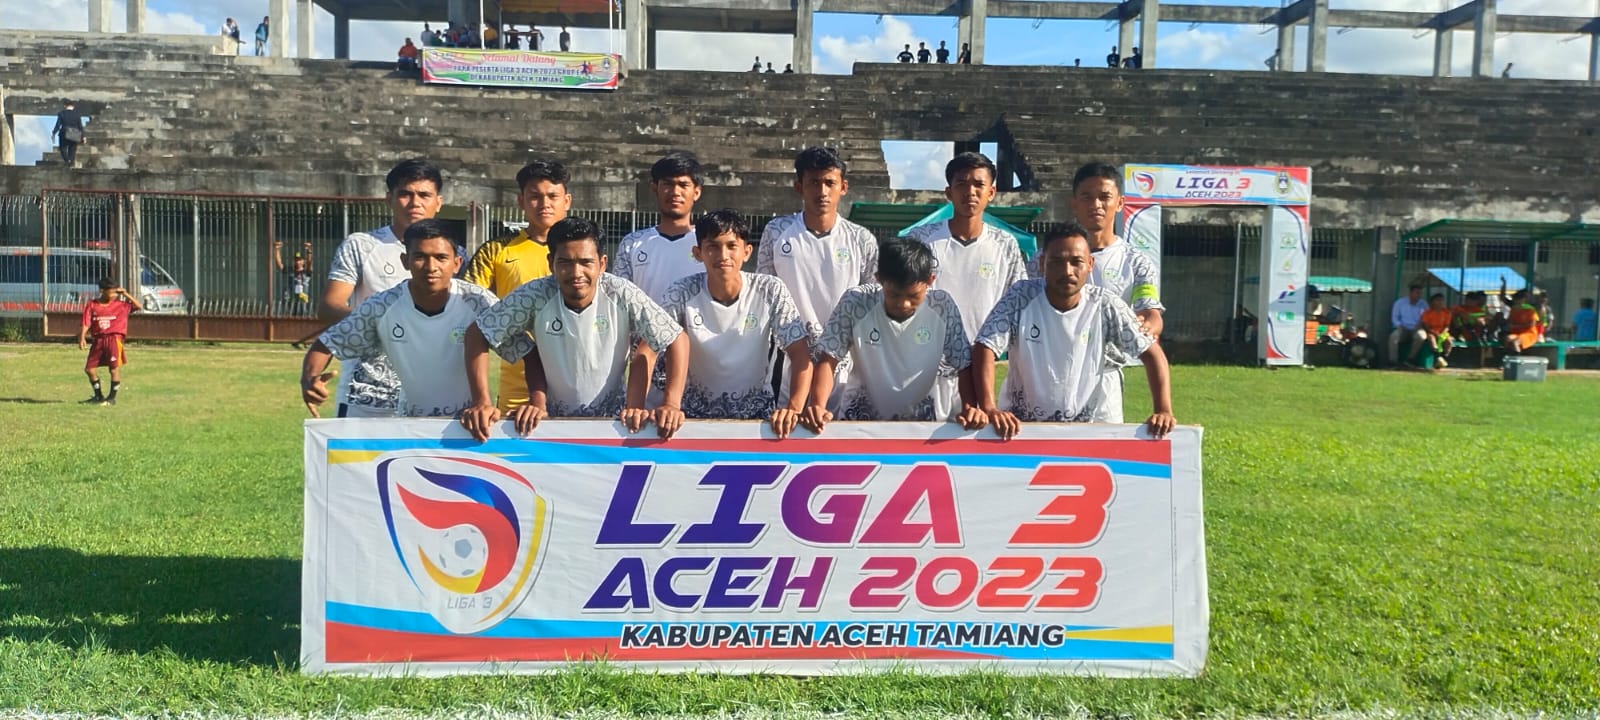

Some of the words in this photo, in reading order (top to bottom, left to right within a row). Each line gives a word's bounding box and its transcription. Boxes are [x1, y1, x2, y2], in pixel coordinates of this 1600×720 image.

[482, 54, 518, 63] Selamat
[522, 54, 557, 66] Datang
[1176, 177, 1229, 189] LIGA
[1236, 177, 1251, 189] 3
[1185, 190, 1211, 198] ACEH
[1213, 191, 1242, 199] 2023
[594, 464, 962, 546] LIGA
[1007, 464, 1115, 546] 3
[582, 556, 835, 610] ACEH
[850, 556, 1103, 610] 2023
[447, 596, 476, 609] LIGA
[482, 596, 493, 609] 3
[621, 624, 815, 648] KABUPATEN
[820, 624, 910, 648] ACEH
[916, 624, 1065, 647] TAMIANG
